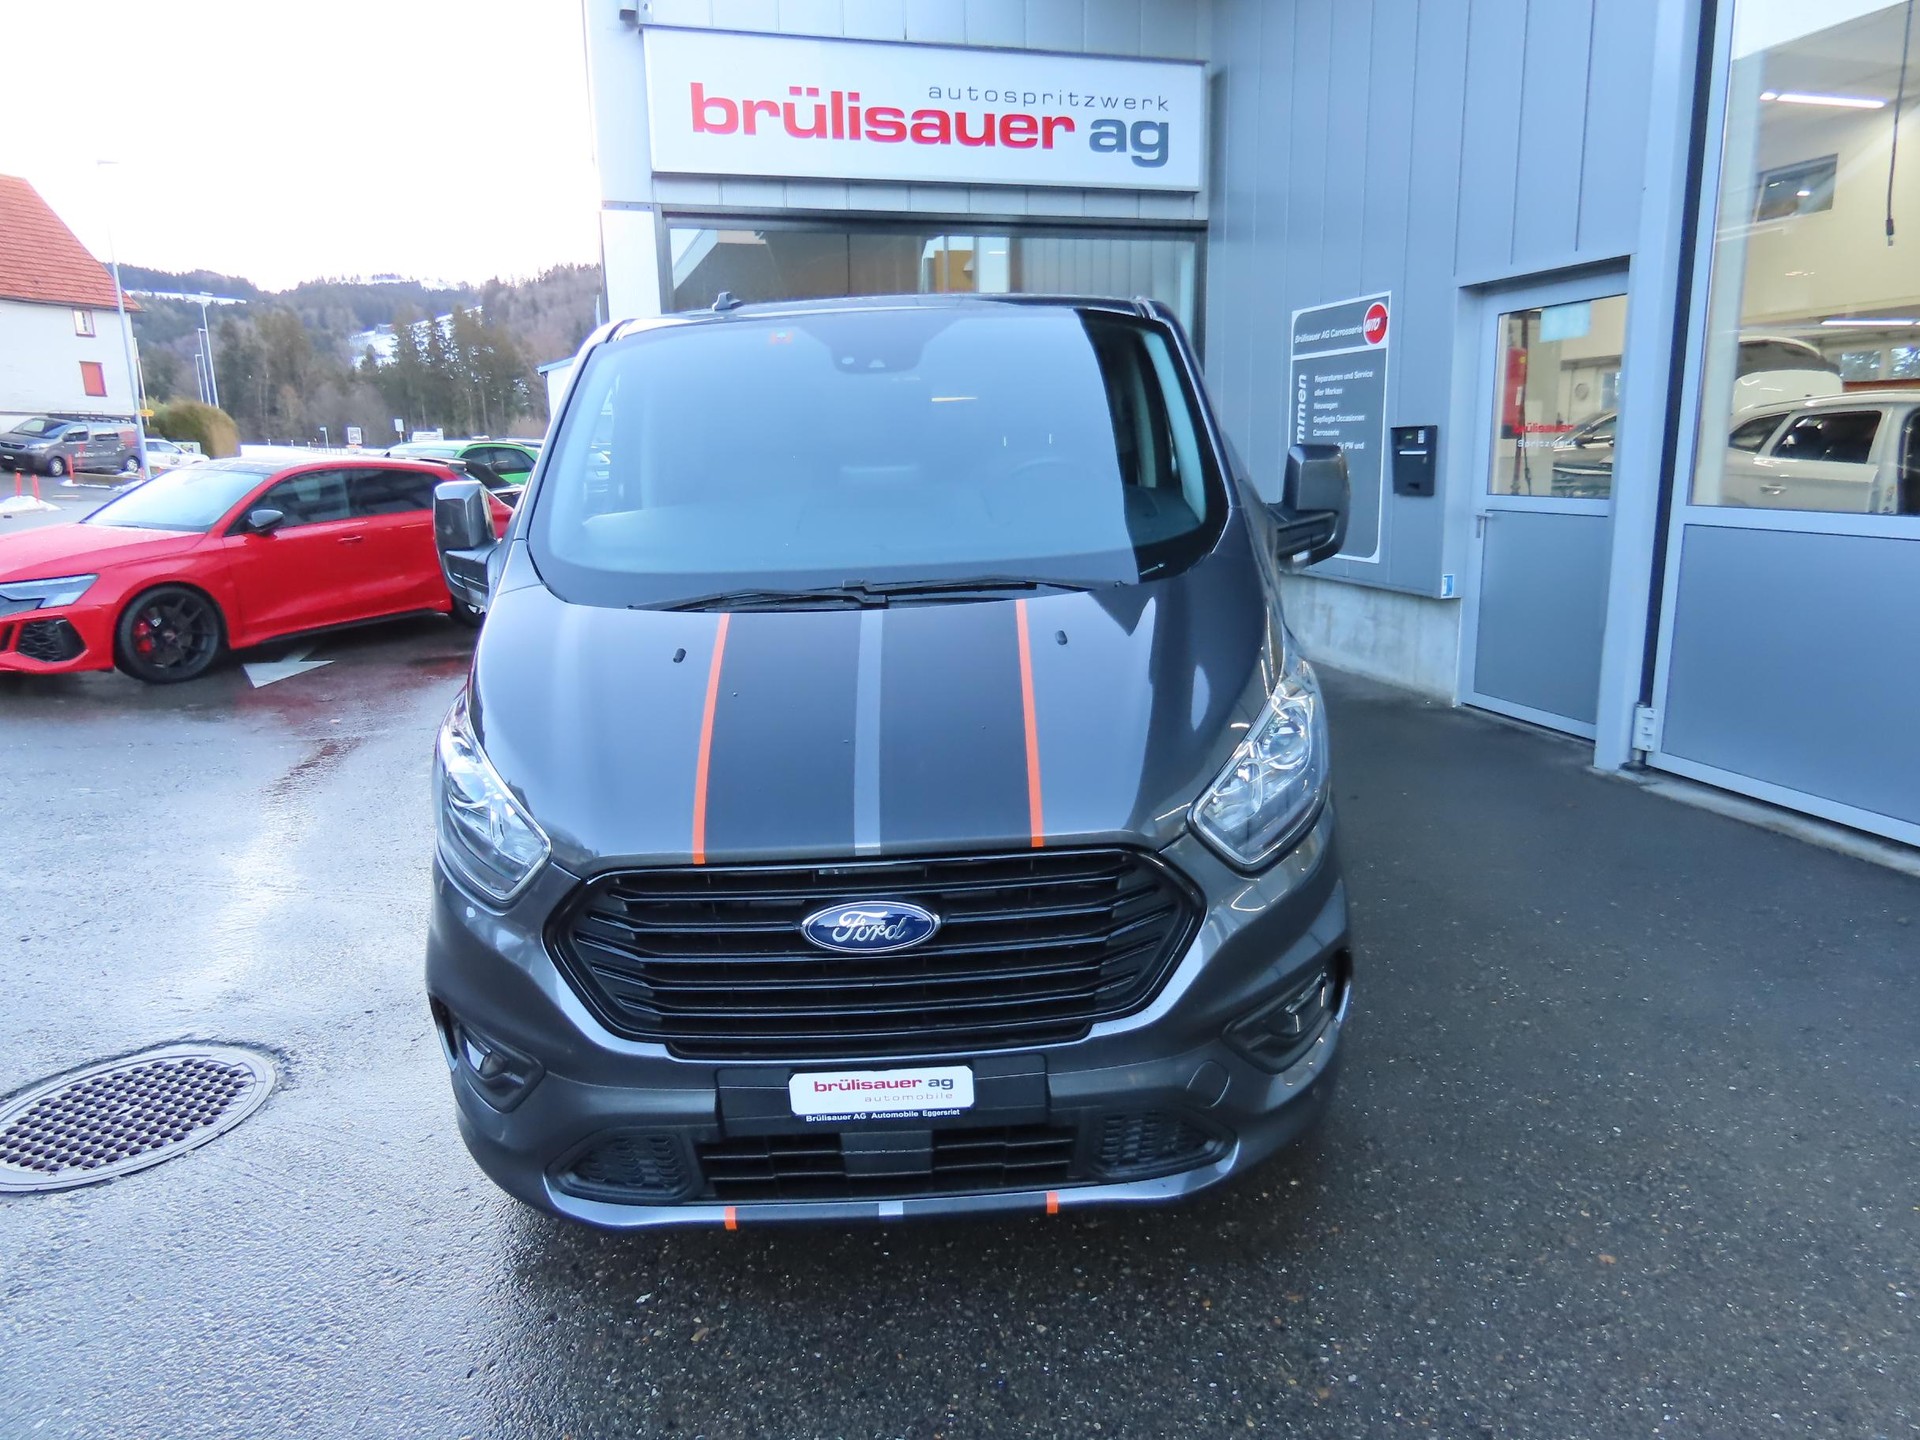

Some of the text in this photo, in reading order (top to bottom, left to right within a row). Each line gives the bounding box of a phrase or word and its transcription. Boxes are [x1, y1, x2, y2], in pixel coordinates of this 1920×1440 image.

[928, 84, 1170, 112] autospritzwerk
[690, 81, 1169, 169] brülisauer ag
[1321, 330, 1330, 339] AG
[1331, 325, 1362, 338] Carrosserie
[1314, 370, 1373, 383] Reparaturen und Service
[1336, 414, 1365, 422] Occasionen
[1513, 422, 1574, 433] ülisauer
[831, 910, 908, 943] Ford
[813, 1077, 954, 1093] brülisauer ag
[864, 1092, 954, 1104] automobile
[805, 1112, 852, 1123] Brülisauer
[853, 1111, 867, 1121] AG
[871, 1110, 919, 1119] Automobile
